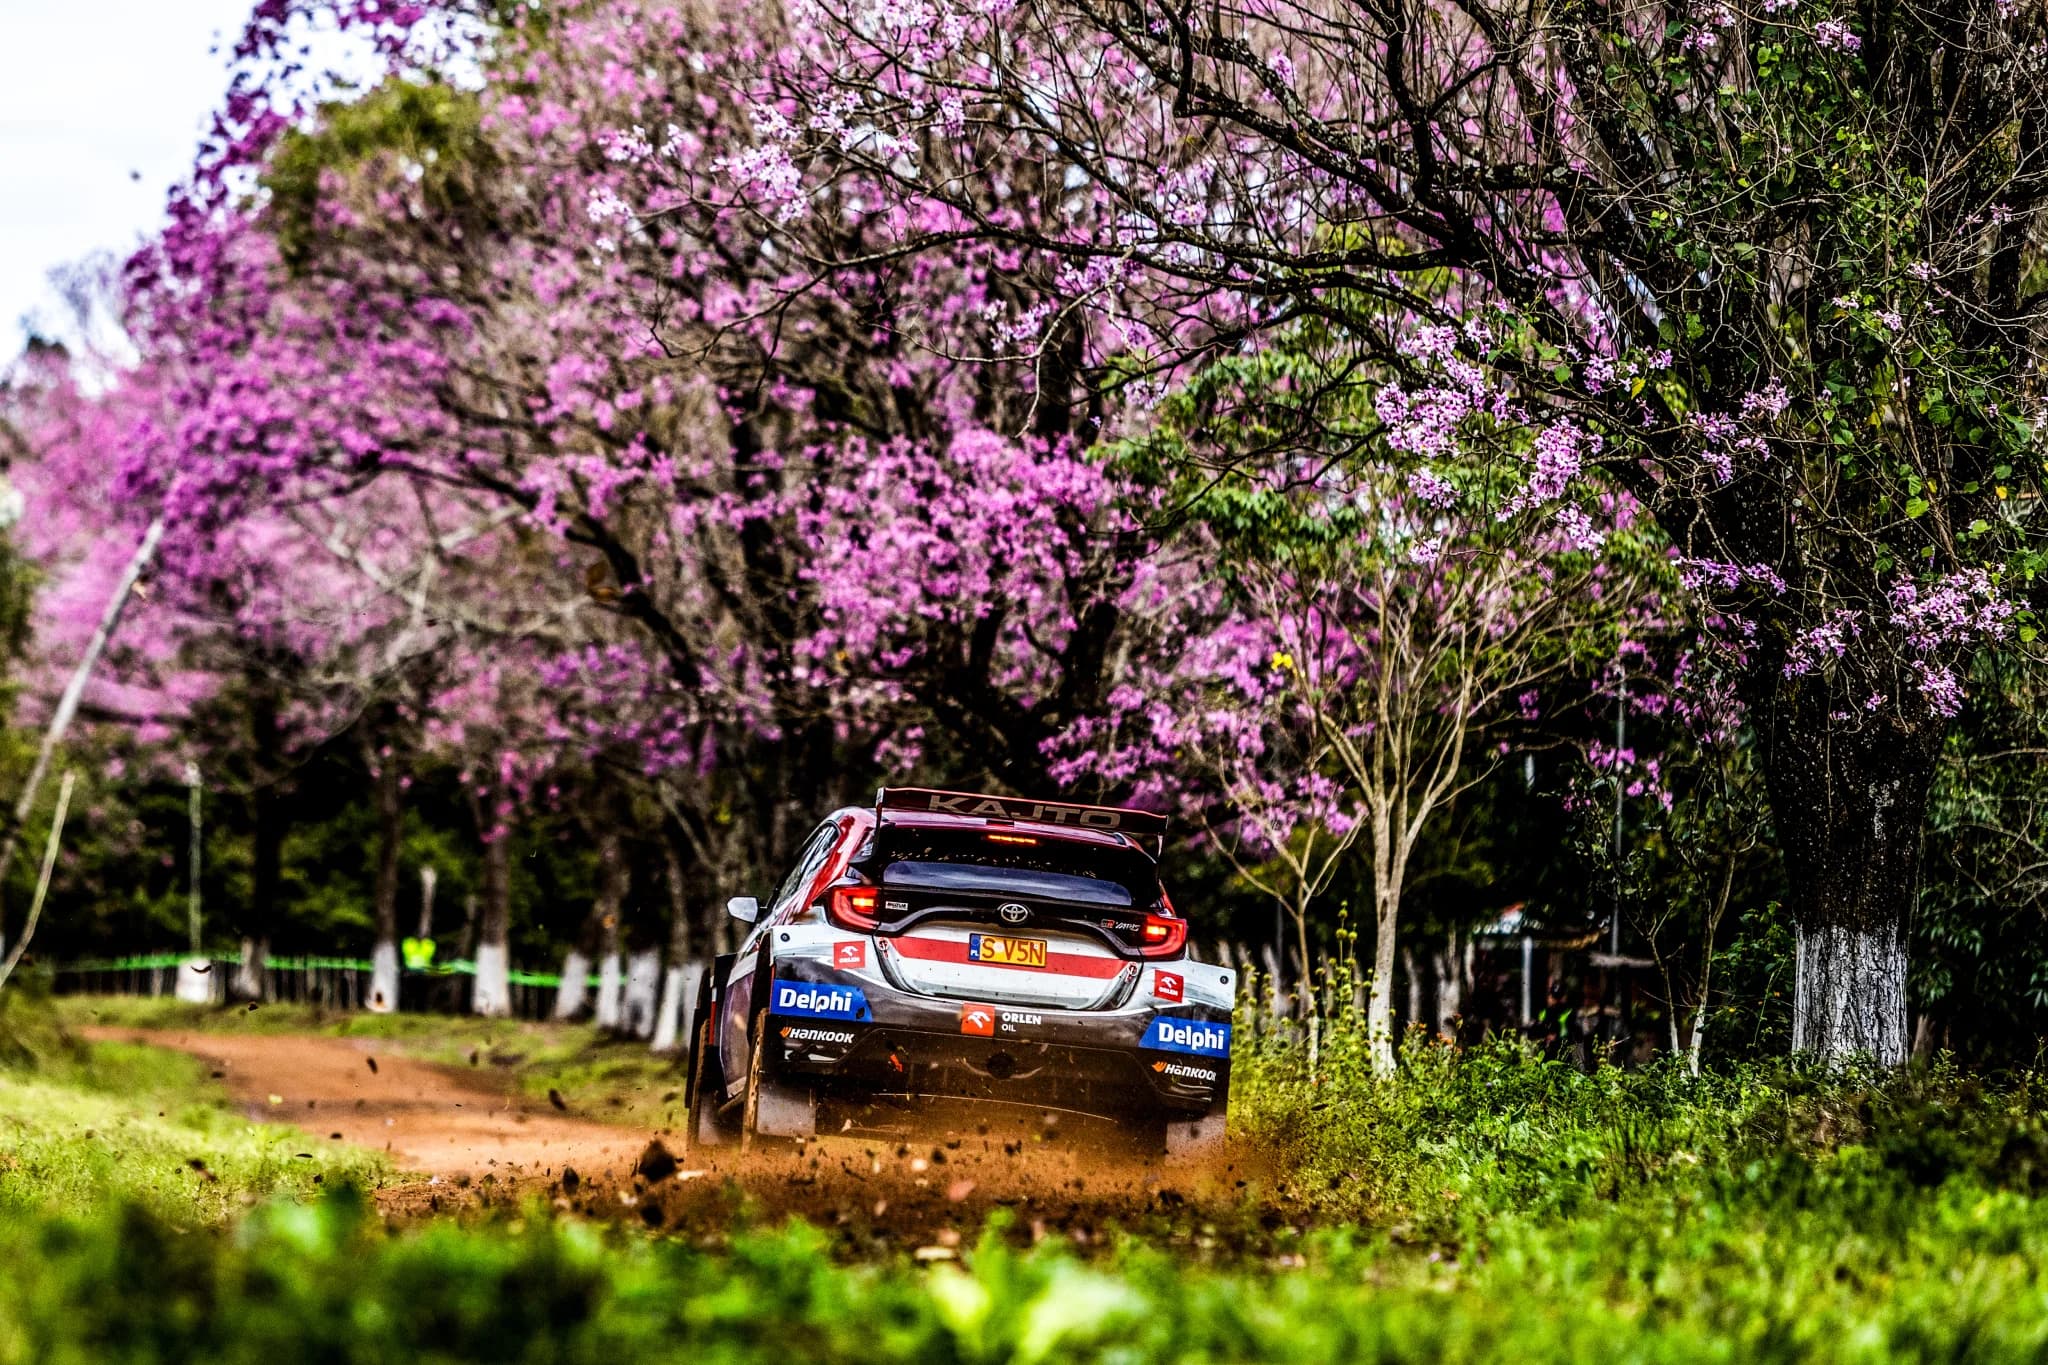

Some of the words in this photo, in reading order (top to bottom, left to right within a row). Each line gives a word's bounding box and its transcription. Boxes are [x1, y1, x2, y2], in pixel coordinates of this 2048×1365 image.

[928, 794, 1121, 829] KAJTO
[981, 938, 996, 959] S
[1003, 939, 1044, 964] V5N
[779, 988, 853, 1013] Delphi
[1001, 1012, 1042, 1025] ORLEN
[1001, 1024, 1017, 1032] OIL
[1158, 1022, 1225, 1050] Delphi
